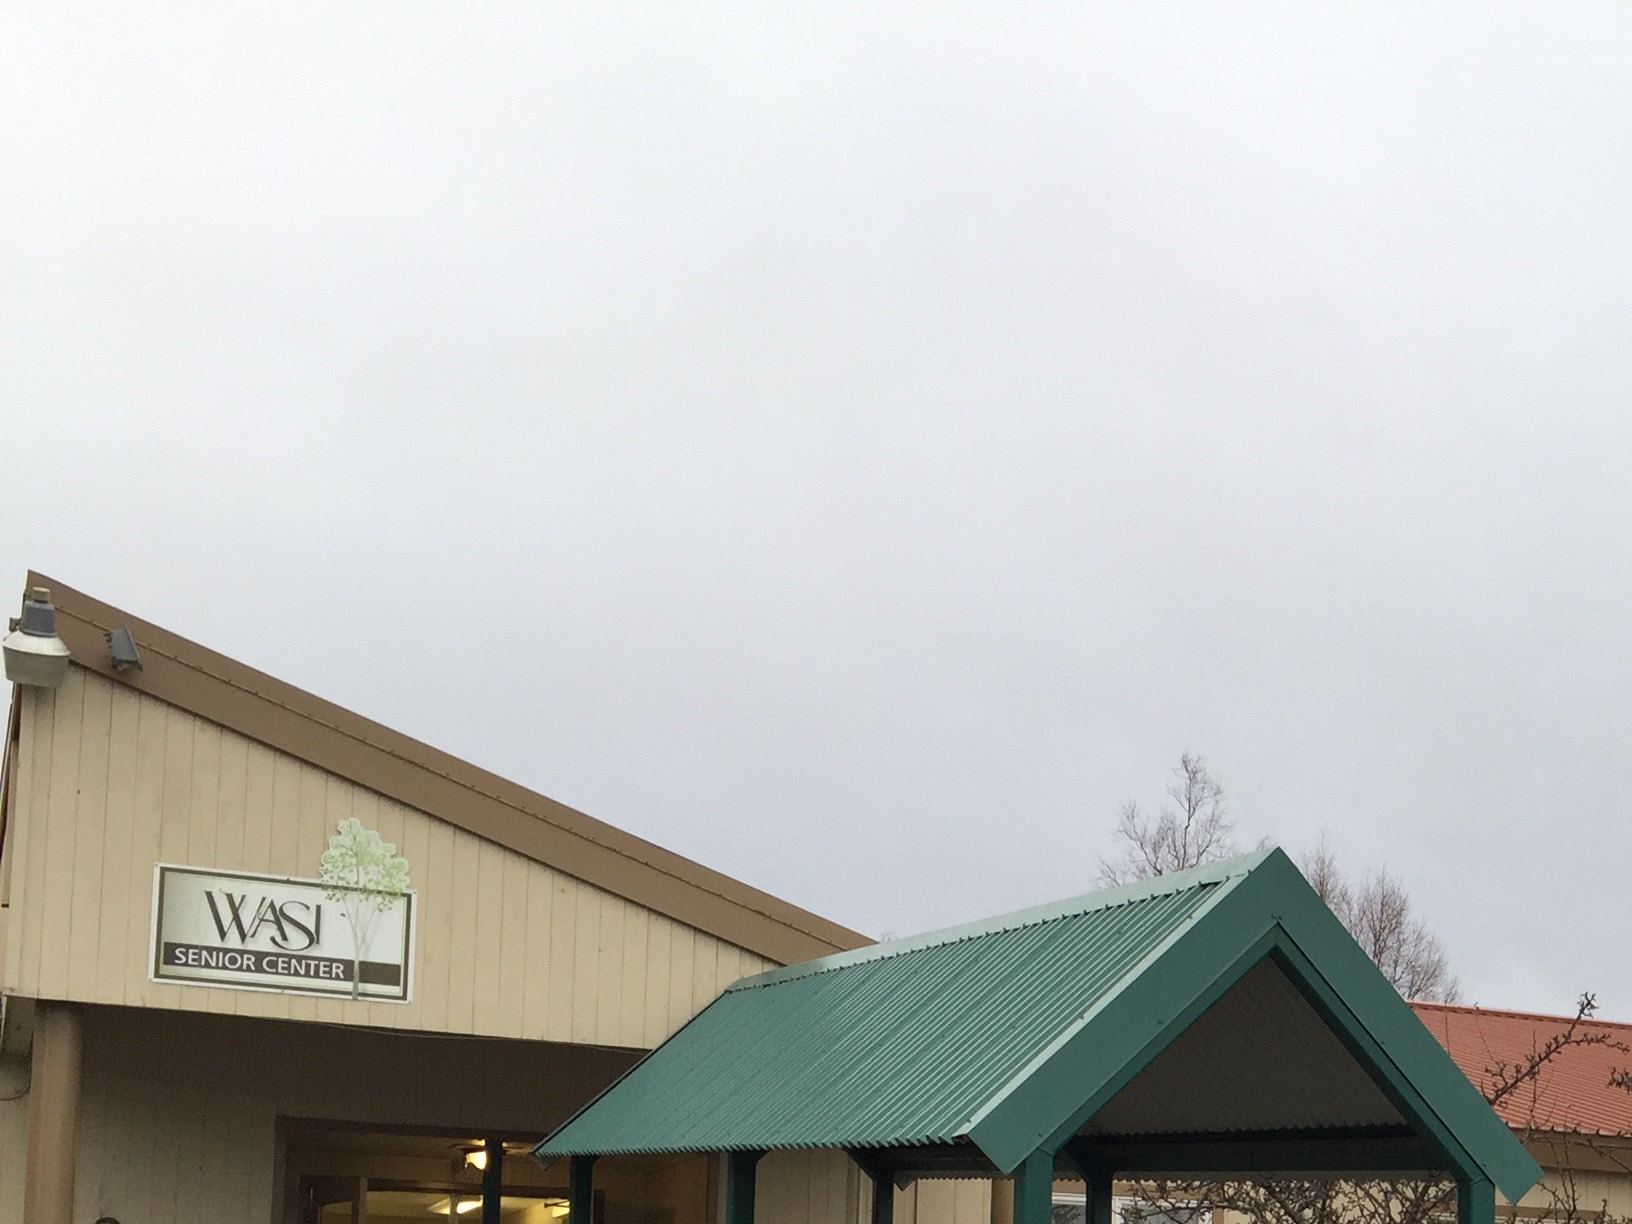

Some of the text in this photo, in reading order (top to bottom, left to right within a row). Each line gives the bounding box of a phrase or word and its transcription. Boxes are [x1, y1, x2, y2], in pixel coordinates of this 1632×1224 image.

[203, 887, 322, 951] WASI
[174, 947, 345, 979] SENIOR CENTER
